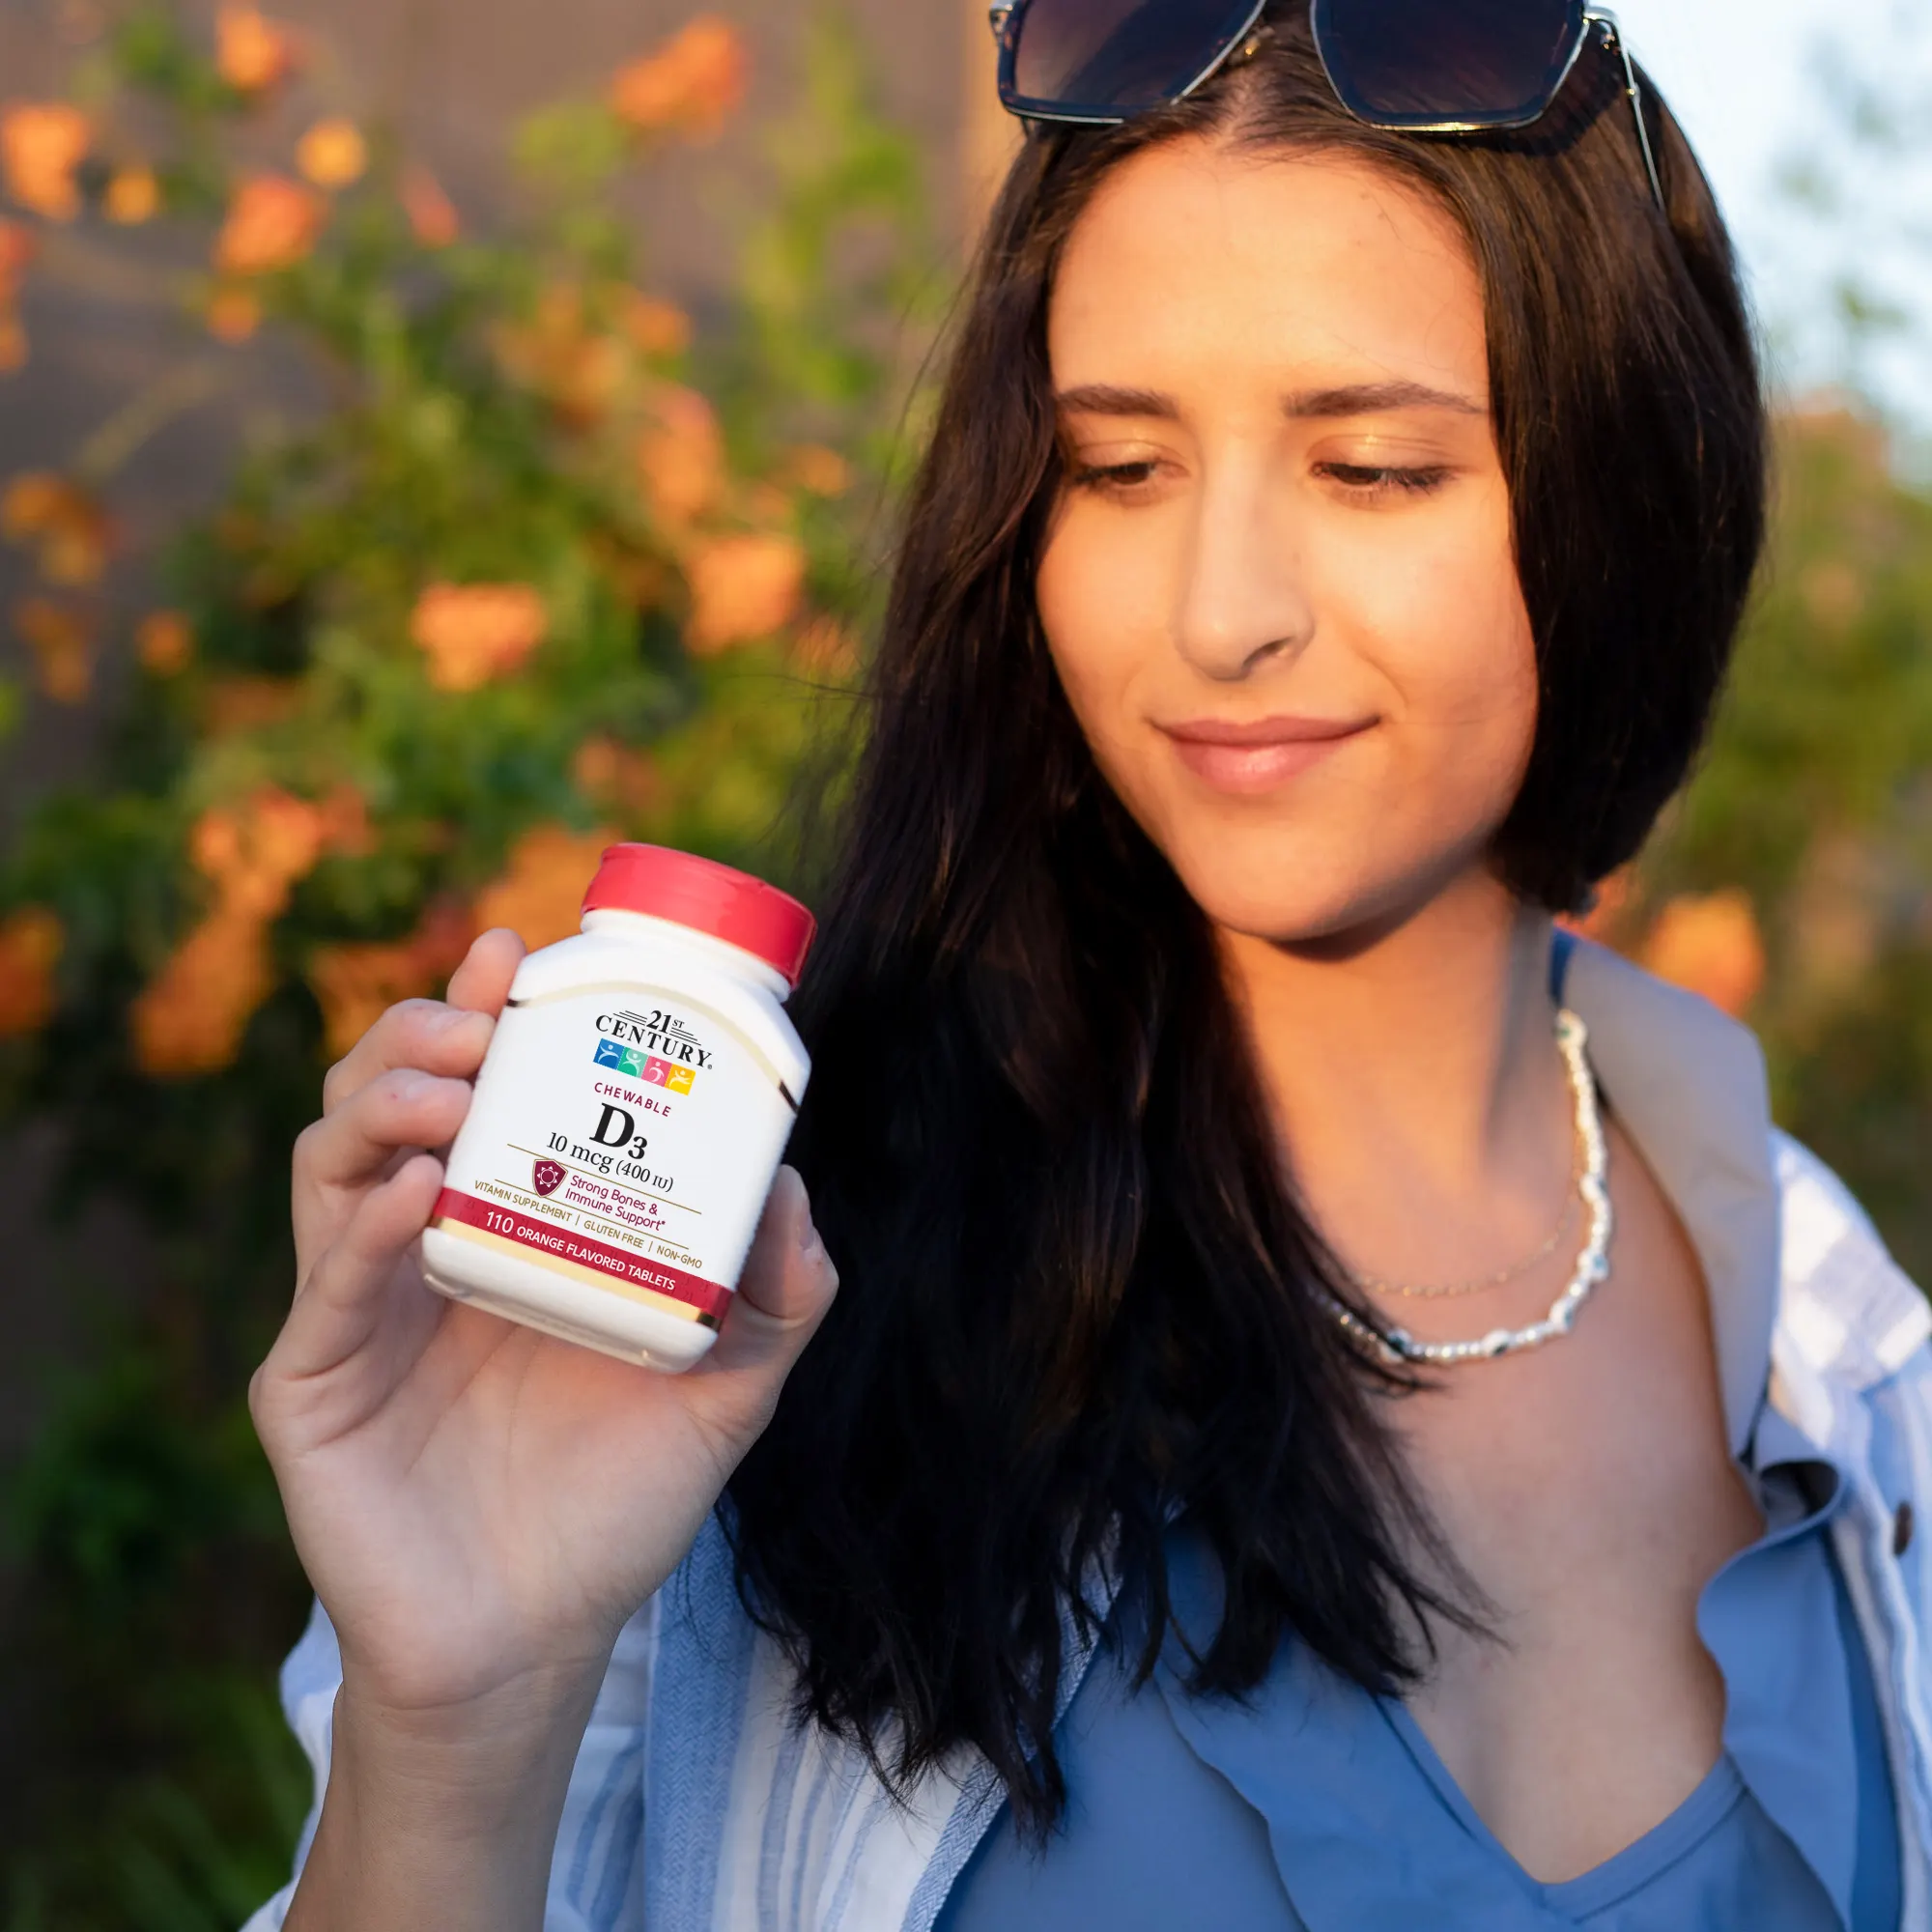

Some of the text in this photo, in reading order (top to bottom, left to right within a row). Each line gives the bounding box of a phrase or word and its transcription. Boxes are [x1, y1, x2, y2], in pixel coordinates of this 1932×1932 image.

[594, 1082, 671, 1117] CHEWABLE
[589, 1102, 648, 1159] D3
[547, 1132, 674, 1193] 10 mcg (400 IU)
[474, 1179, 573, 1222] VITAMIN SUPPLEMENT
[565, 1188, 613, 1214] Immune
[571, 1175, 659, 1216] Strong Bones &
[486, 1210, 515, 1234] 110
[516, 1226, 565, 1252] ORANGE
[566, 1243, 626, 1272] FLAVORED
[628, 1264, 676, 1291] TABLETS
[583, 1220, 644, 1249] GLUTEN FREE
[657, 1245, 703, 1269] NON-GMO
